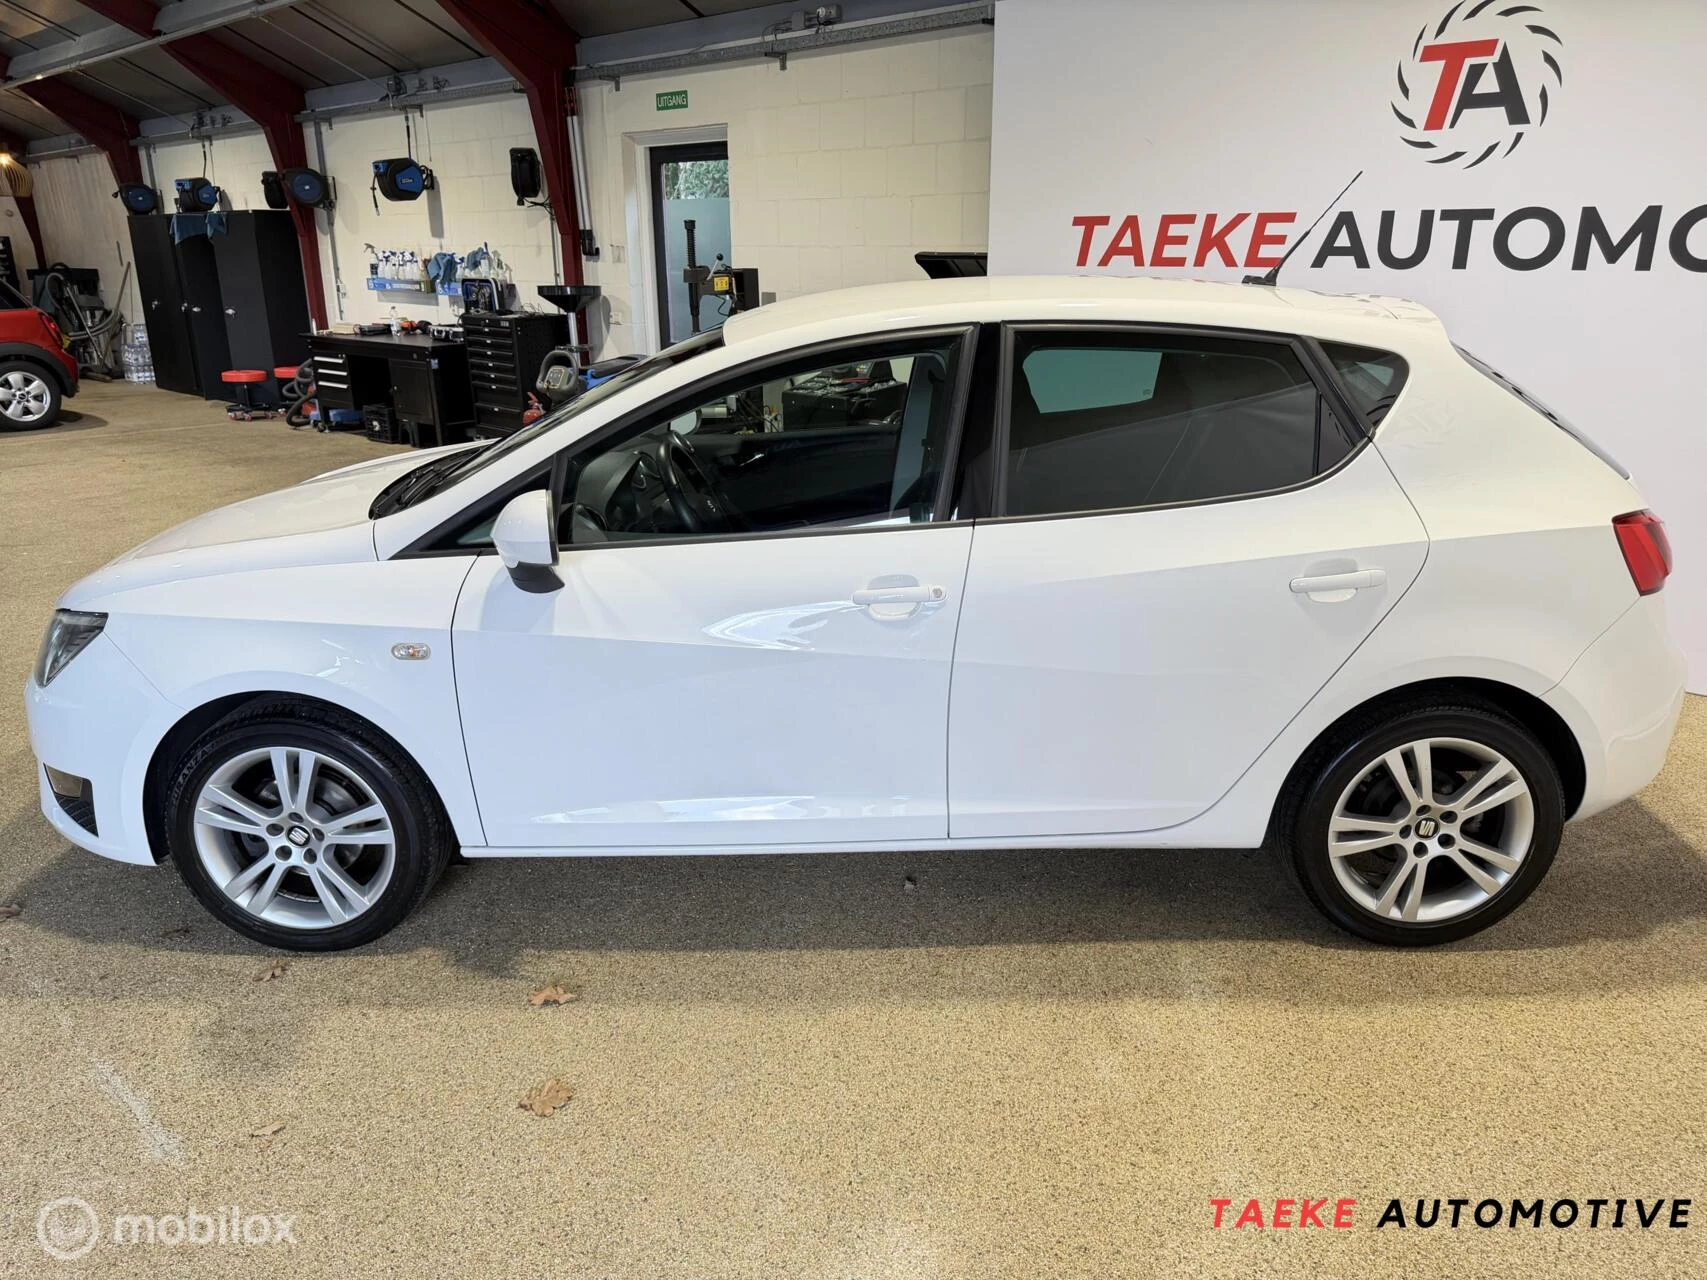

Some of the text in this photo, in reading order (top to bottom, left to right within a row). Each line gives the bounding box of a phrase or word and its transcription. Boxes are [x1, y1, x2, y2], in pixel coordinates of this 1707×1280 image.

[657, 93, 688, 108] UITGANG
[1418, 38, 1532, 131] TA
[1071, 212, 1298, 268] TAEKE
